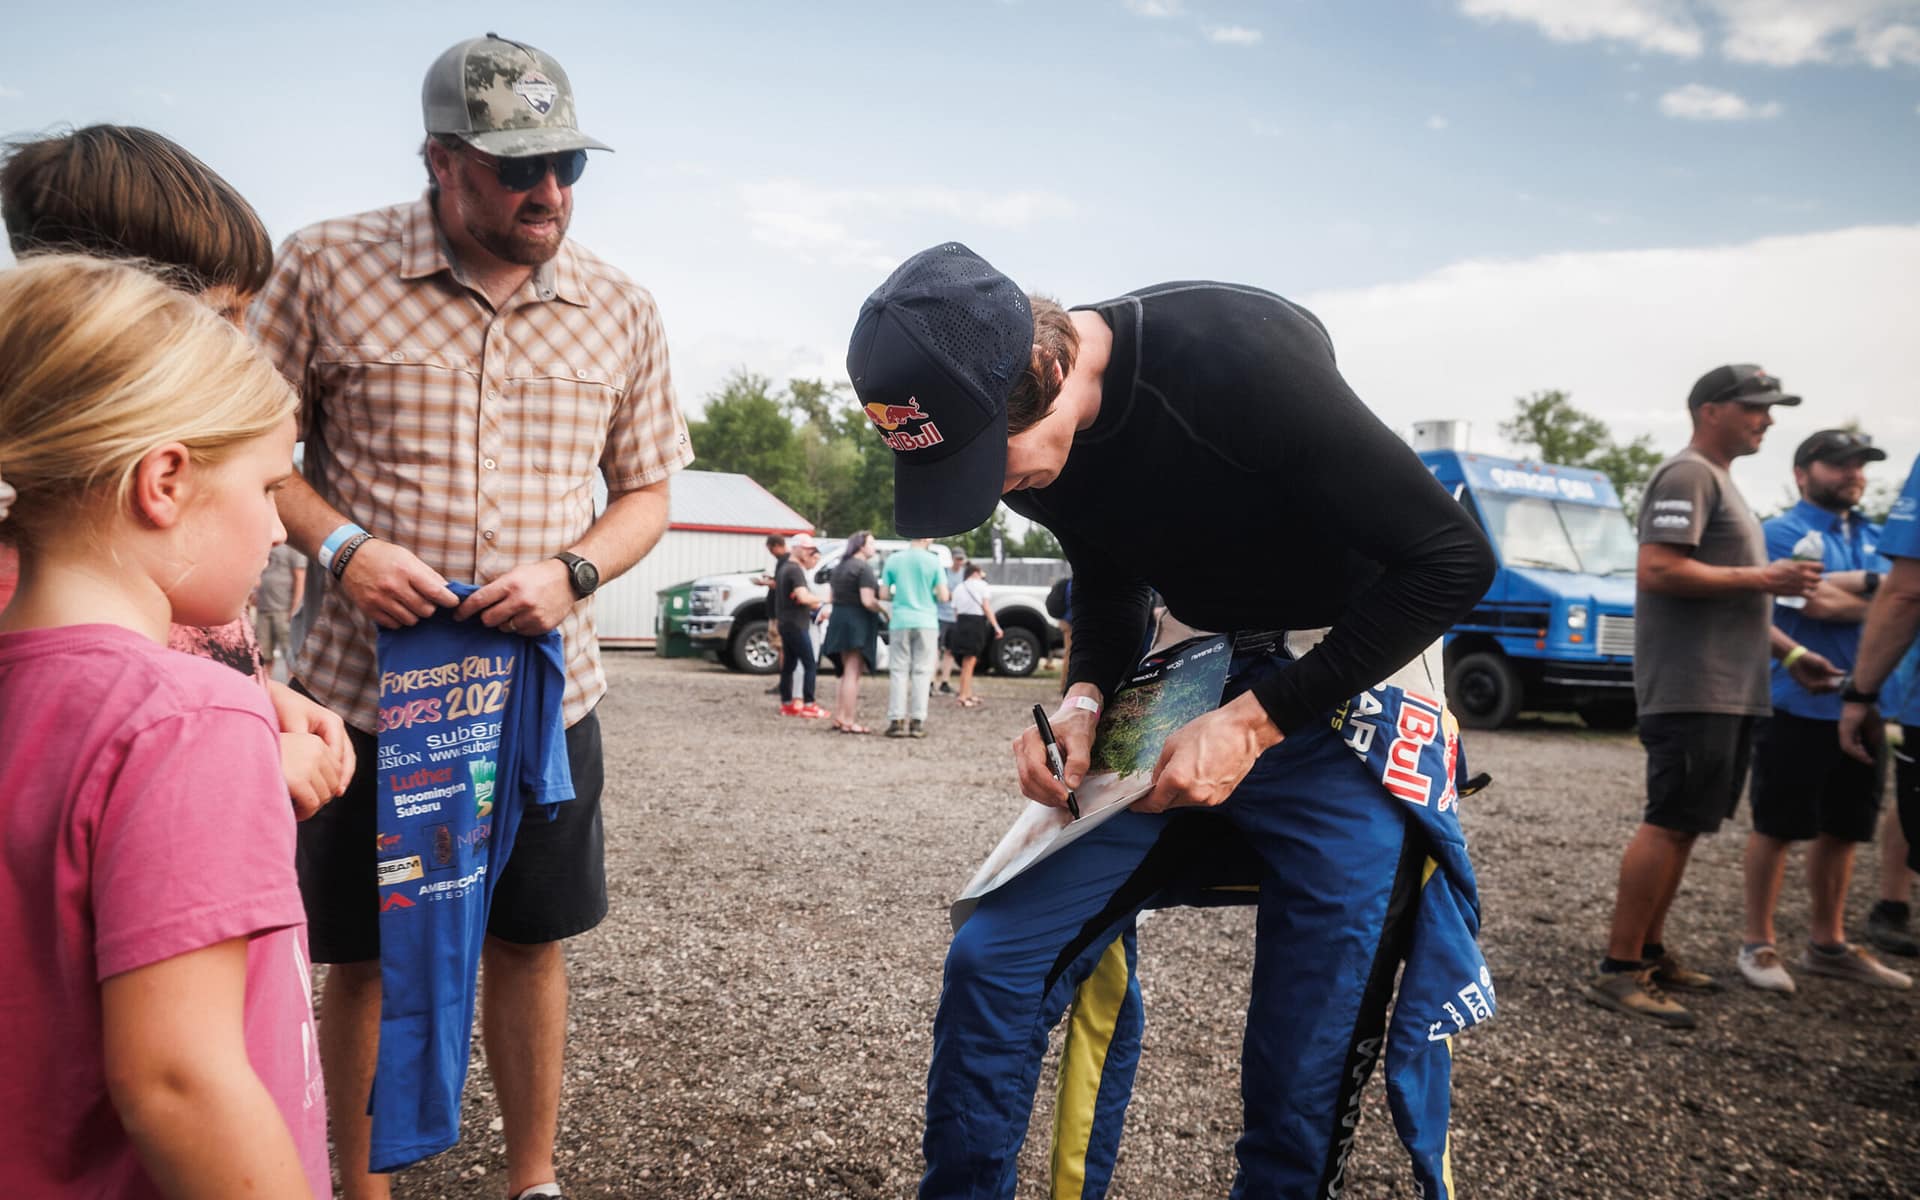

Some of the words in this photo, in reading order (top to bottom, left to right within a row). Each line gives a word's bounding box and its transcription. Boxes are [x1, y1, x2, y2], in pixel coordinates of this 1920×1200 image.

[896, 421, 944, 451] Bull
[380, 662, 460, 698] FORESTS
[1382, 701, 1439, 807] Bull
[390, 767, 453, 792] Luther
[393, 783, 466, 807] Bloomington
[396, 802, 441, 818] Subaru
